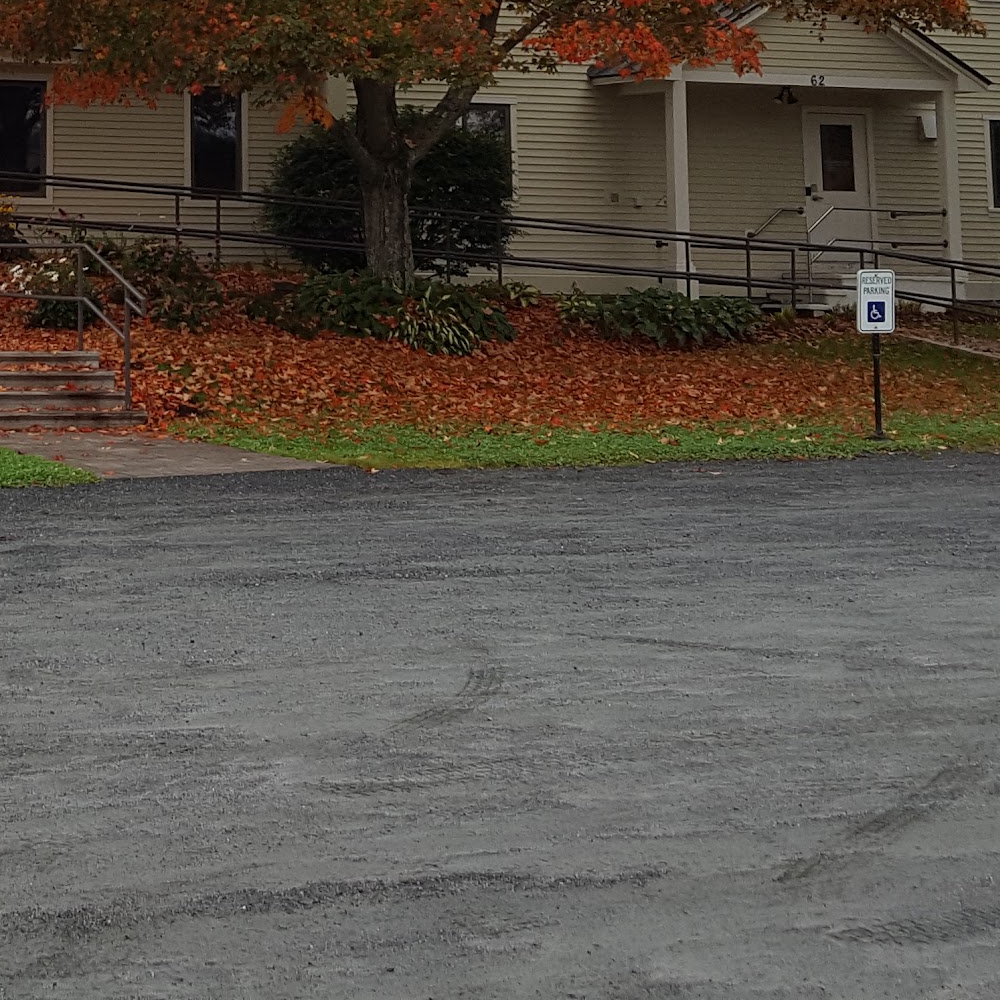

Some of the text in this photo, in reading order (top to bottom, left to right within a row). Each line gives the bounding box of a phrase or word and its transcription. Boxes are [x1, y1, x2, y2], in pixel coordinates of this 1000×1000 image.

[810, 74, 825, 86] 62
[862, 276, 892, 284] RESERVED
[863, 286, 890, 295] PARKING
